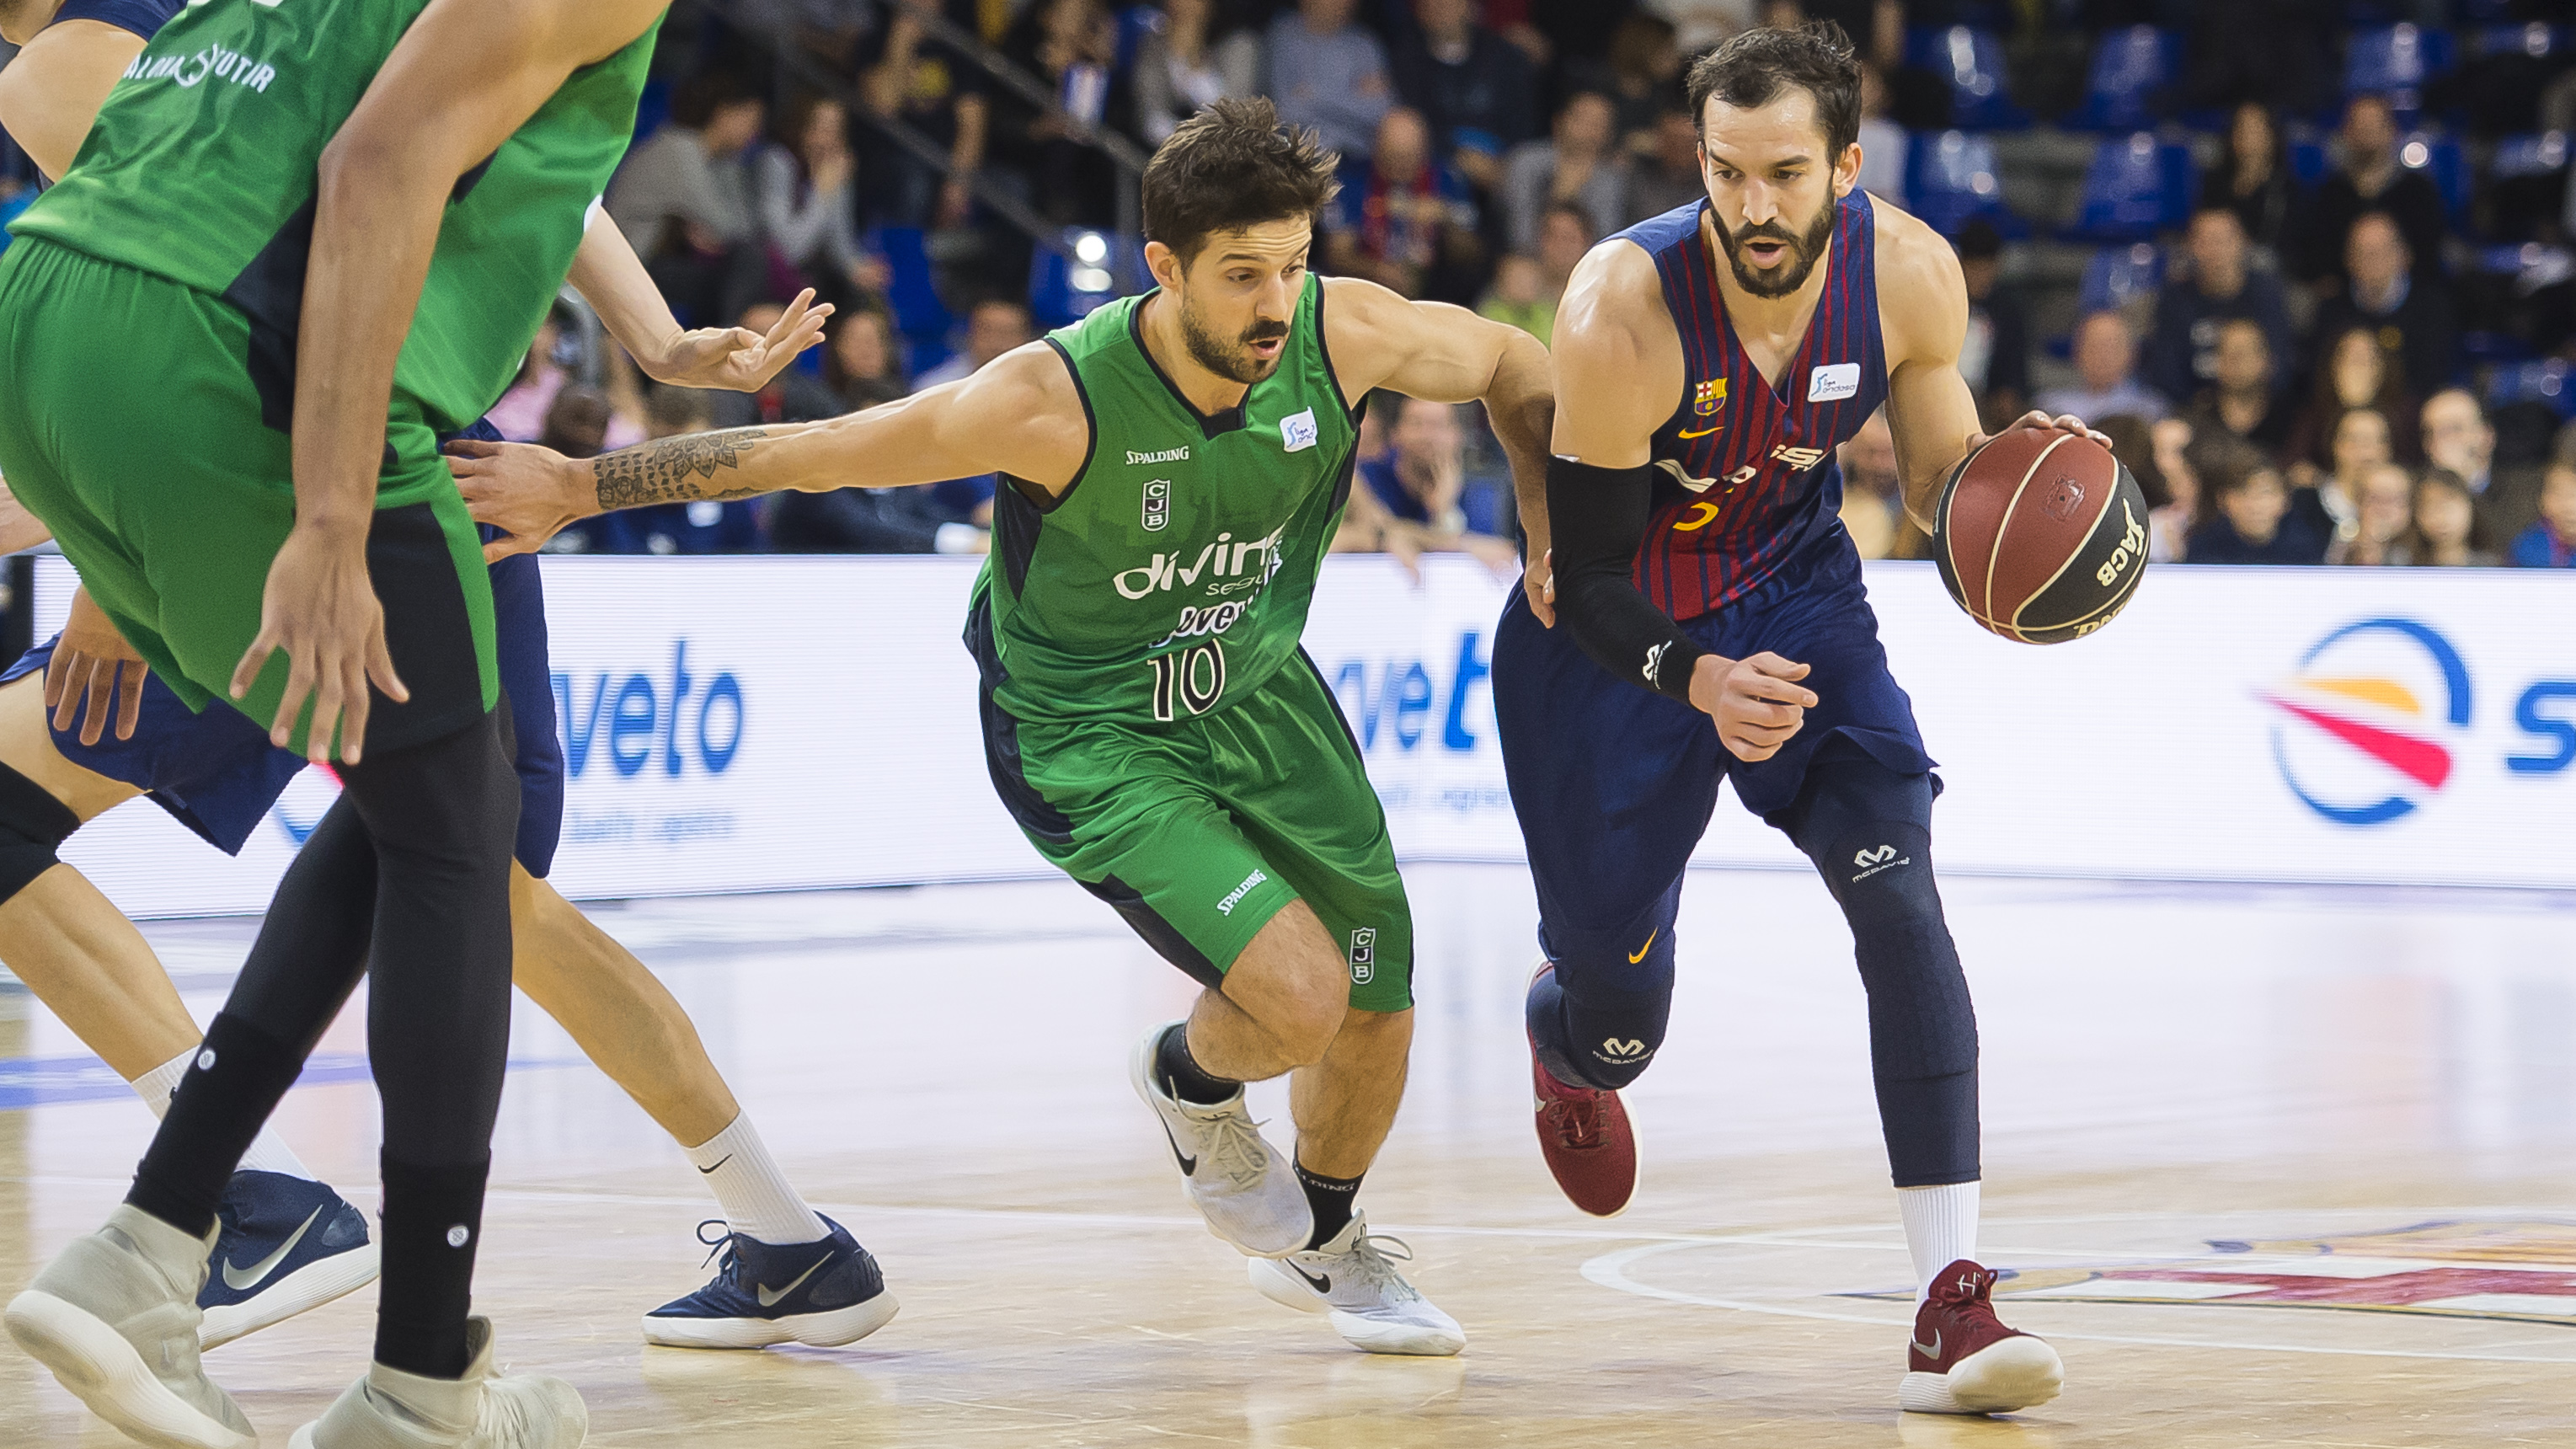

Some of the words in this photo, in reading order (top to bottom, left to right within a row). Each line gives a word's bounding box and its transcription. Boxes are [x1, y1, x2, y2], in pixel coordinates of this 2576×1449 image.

[1125, 446, 1189, 465] SPALDING
[552, 638, 745, 778] veto
[1146, 637, 1226, 721] 10
[1216, 869, 1268, 917] SPALDING
